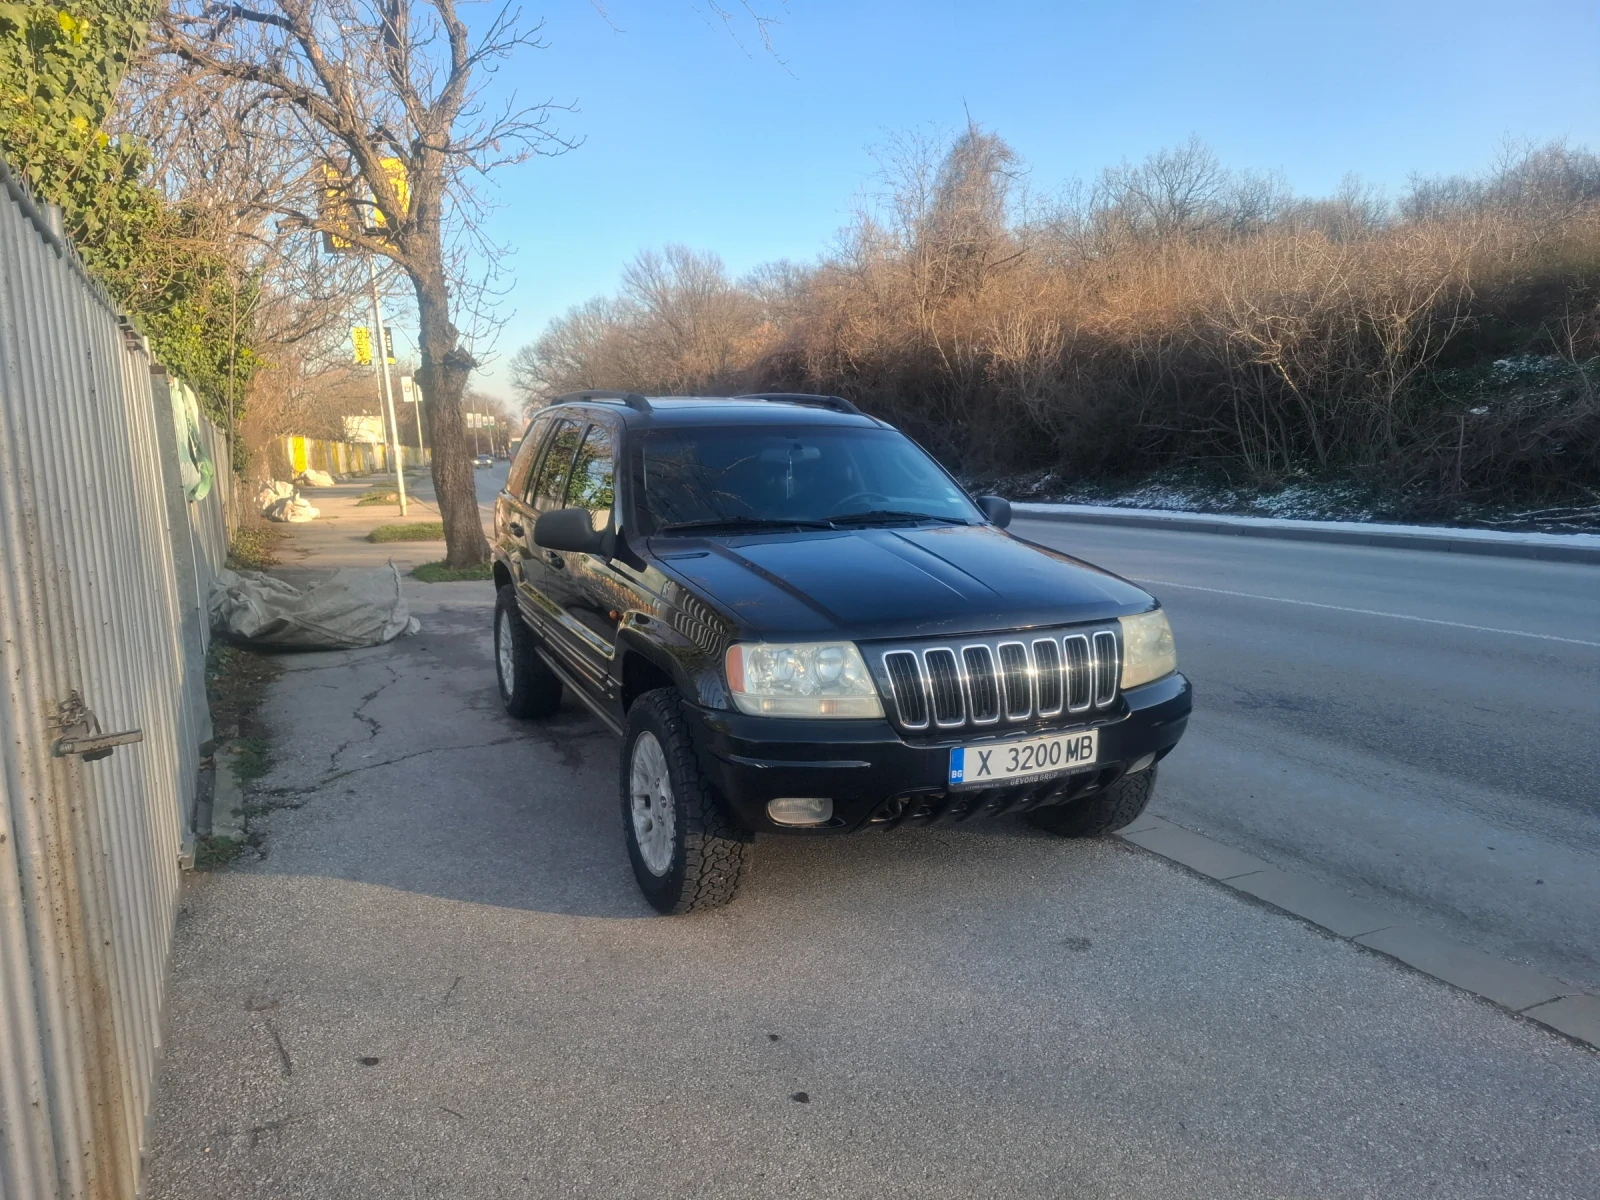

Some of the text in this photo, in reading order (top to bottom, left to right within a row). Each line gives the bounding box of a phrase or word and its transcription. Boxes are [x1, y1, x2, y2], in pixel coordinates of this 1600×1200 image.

[977, 735, 1093, 776] X 3200 MB
[951, 769, 963, 778] BG
[1010, 775, 1039, 786] GEVORG
